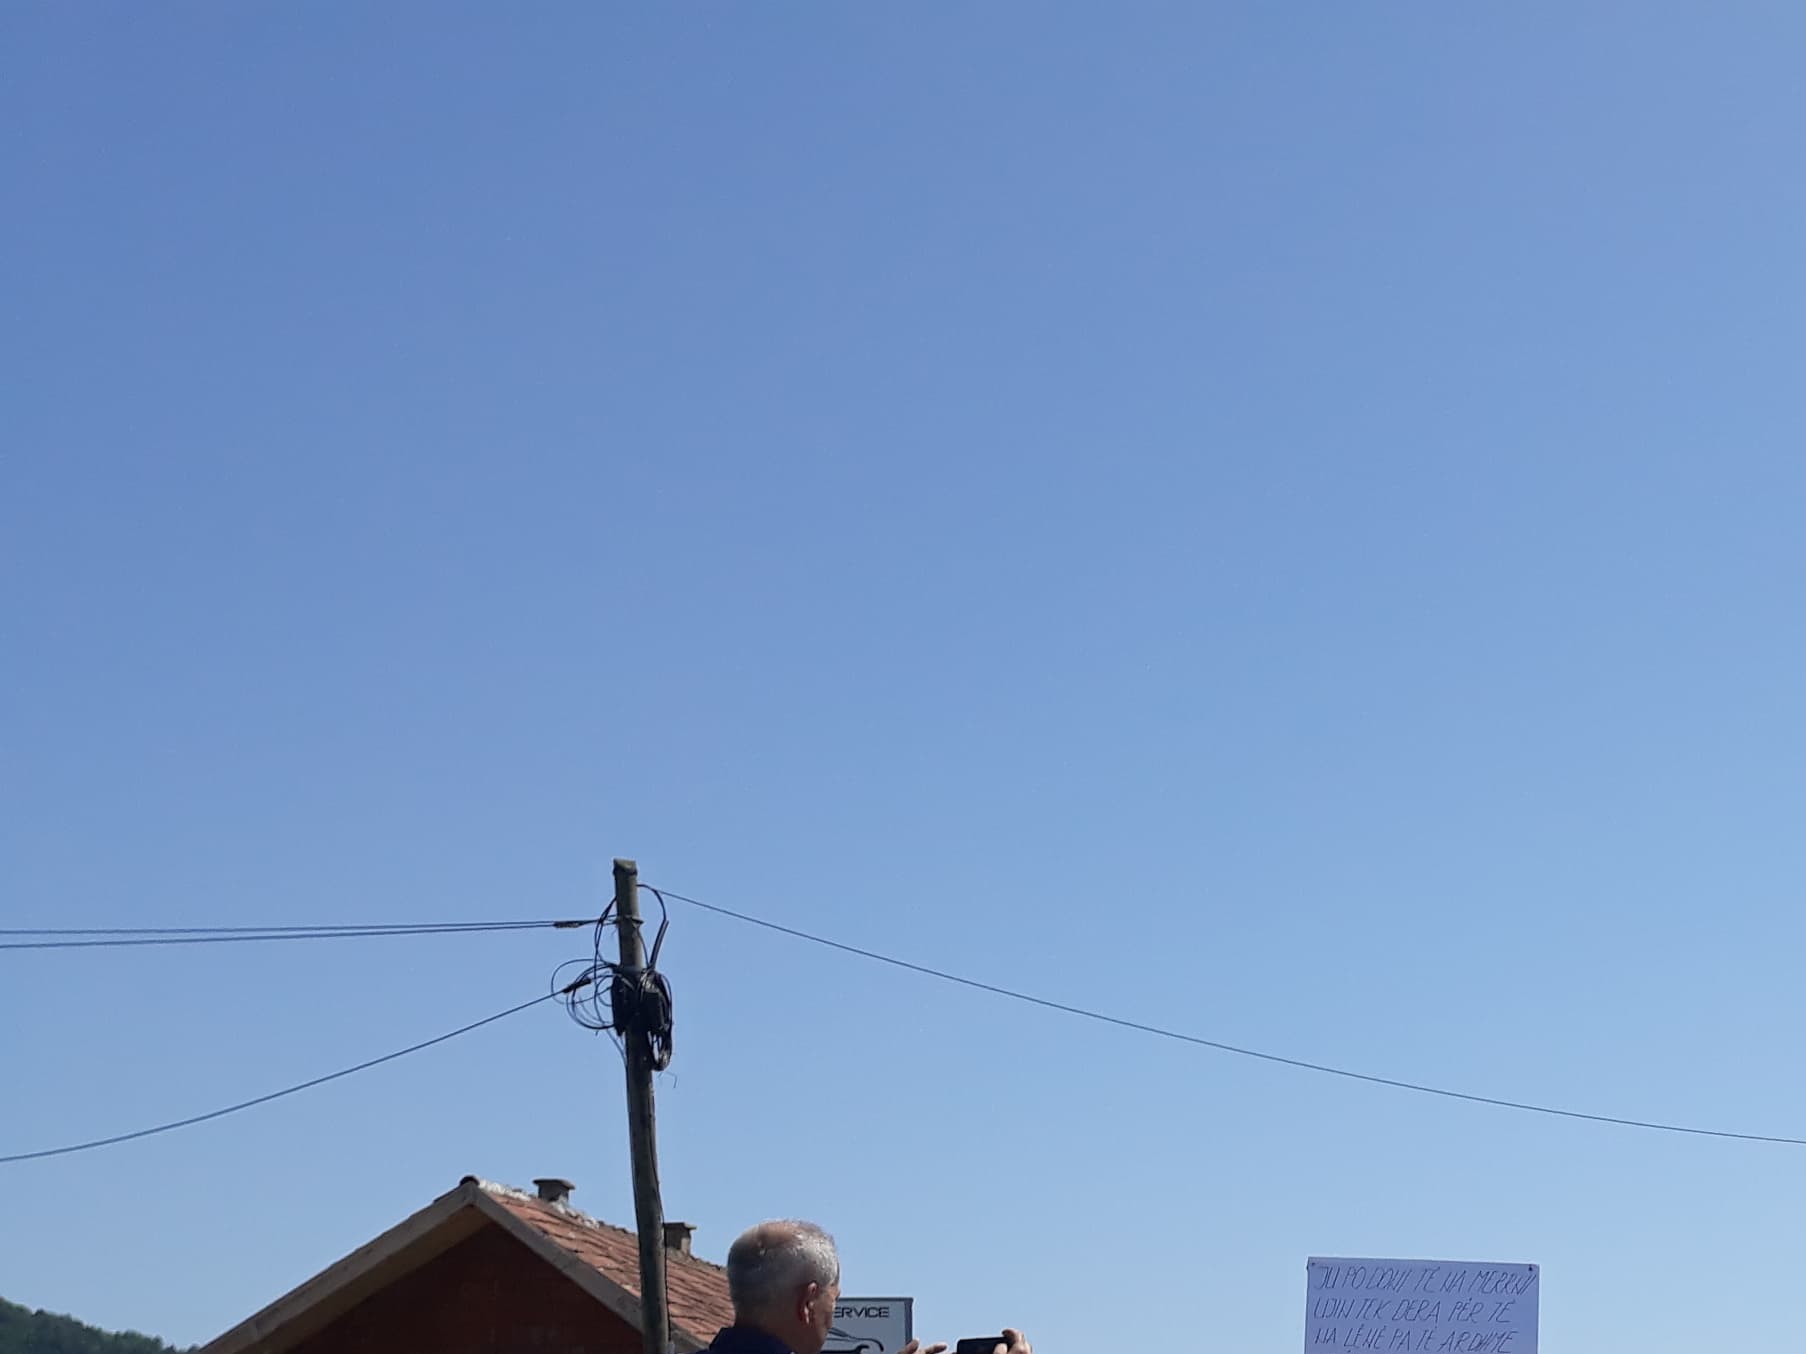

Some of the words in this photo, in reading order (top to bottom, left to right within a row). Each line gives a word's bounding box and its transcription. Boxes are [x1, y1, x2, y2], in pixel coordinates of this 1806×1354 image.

[833, 1306, 890, 1318] ERVICE
[1356, 1298, 1391, 1320] TEK
[1392, 1299, 1440, 1323] DERA
[1314, 1327, 1337, 1345] NA
